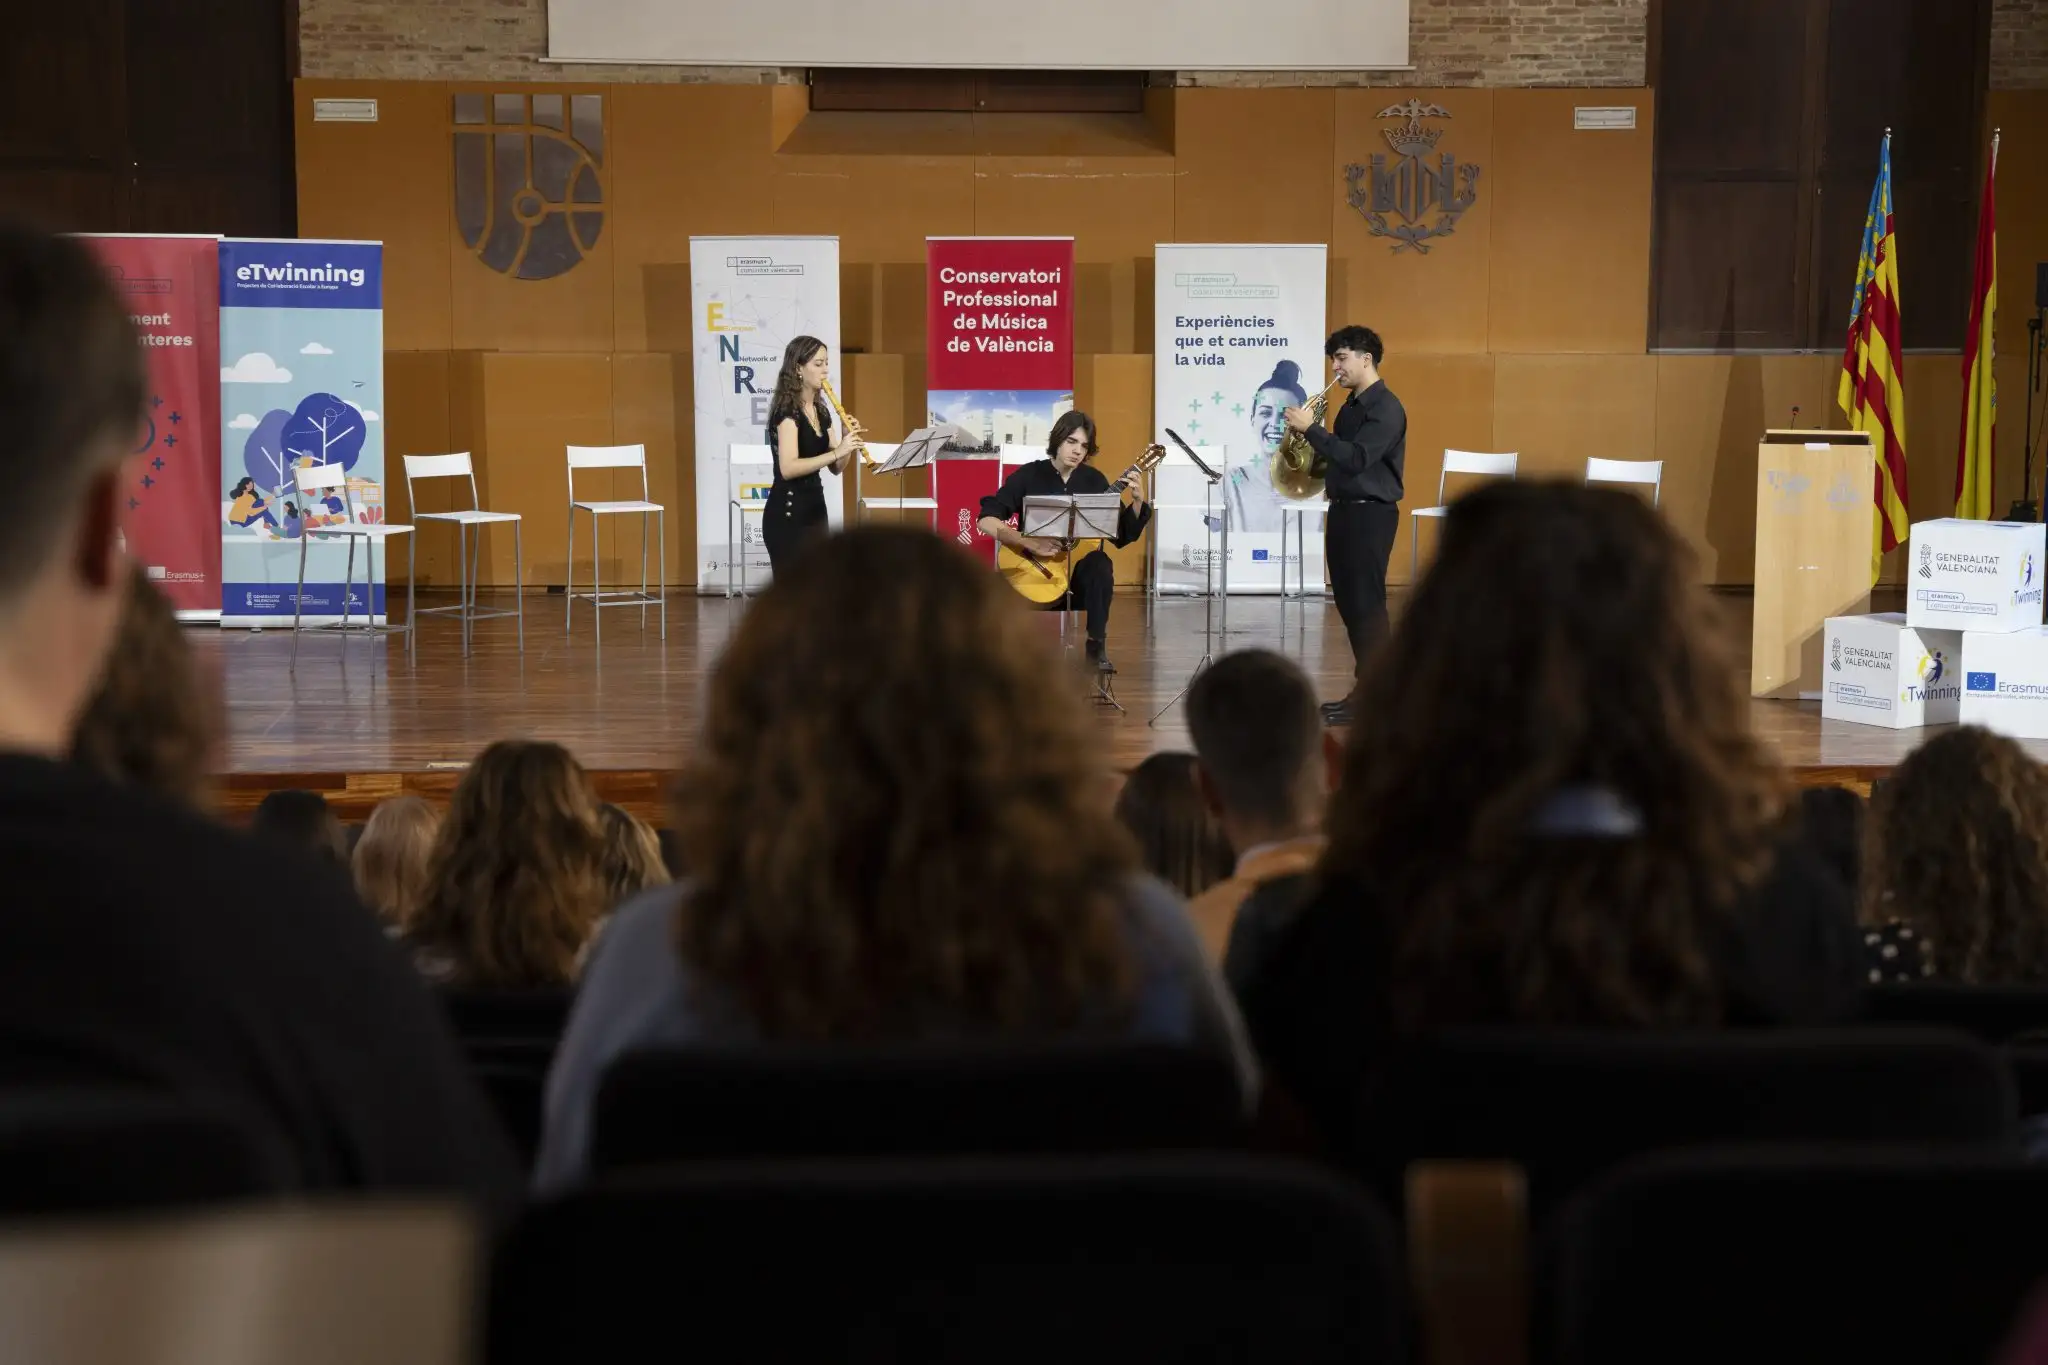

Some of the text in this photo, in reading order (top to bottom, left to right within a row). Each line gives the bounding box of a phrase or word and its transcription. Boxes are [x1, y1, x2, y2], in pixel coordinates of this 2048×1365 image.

[236, 262, 365, 287] eTwinning
[940, 267, 1061, 284] Conservatori
[943, 290, 1058, 307] Professional
[953, 312, 1048, 330] de Música
[1175, 315, 1275, 331] Experiències
[720, 335, 739, 362] N
[947, 336, 1054, 353] de València
[1175, 334, 1288, 350] que et canvien
[1175, 353, 1226, 366] la vida
[734, 366, 757, 394] R
[1936, 552, 2000, 565] GENERALITAT
[166, 571, 206, 579] Erasmus+
[1936, 562, 1998, 575] VALENCIANA
[1930, 592, 1959, 600] erasmus+
[1844, 646, 1893, 661] GENERALITAT
[1844, 656, 1892, 671] VALENCIANA
[1900, 684, 1961, 702] eTwinning
